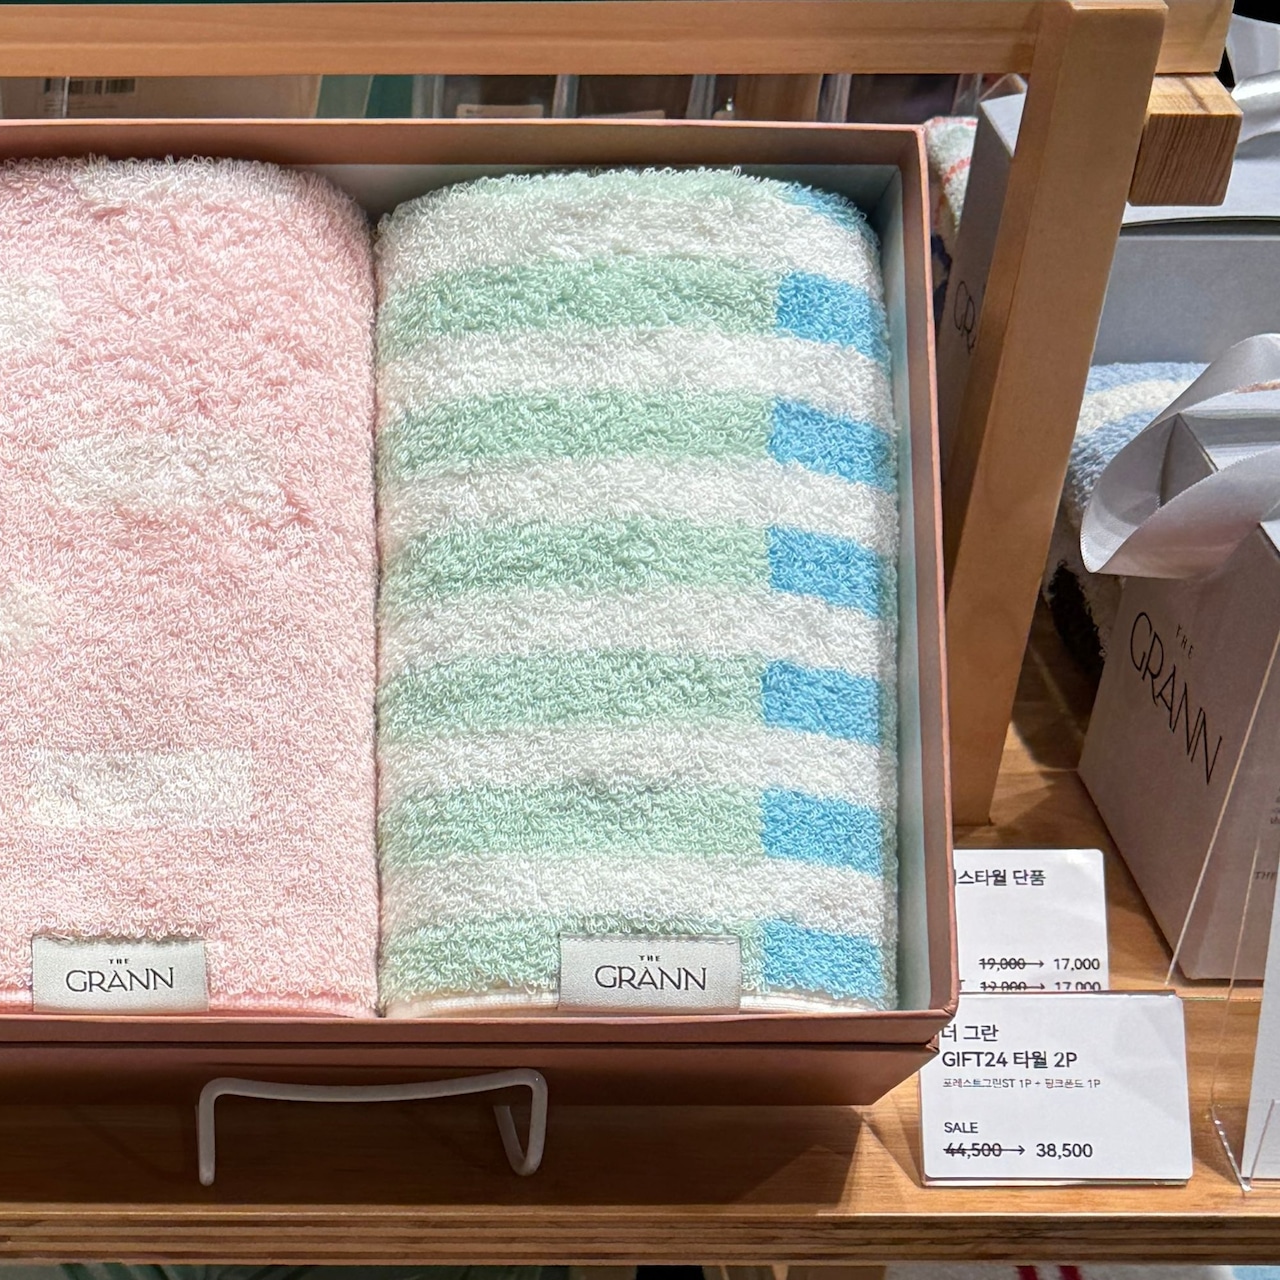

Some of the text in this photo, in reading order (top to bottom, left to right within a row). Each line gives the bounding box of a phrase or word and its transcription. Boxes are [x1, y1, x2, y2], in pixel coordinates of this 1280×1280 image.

[1130, 611, 1223, 786] GRANN
[955, 868, 1047, 887] 스타월 단품
[107, 956, 131, 966] THE
[638, 953, 662, 964] THE
[1052, 957, 1101, 973] 17,000
[64, 966, 175, 994] GRANN
[593, 963, 708, 992] GRANN
[940, 1024, 1000, 1043] 더 그란
[941, 1050, 1078, 1070] GIFT24 타월 2P
[1019, 1078, 1032, 1090] 1P
[1087, 1078, 1101, 1090] 1P
[943, 1121, 980, 1135] SALE
[1035, 1142, 1094, 1160] 38,500
